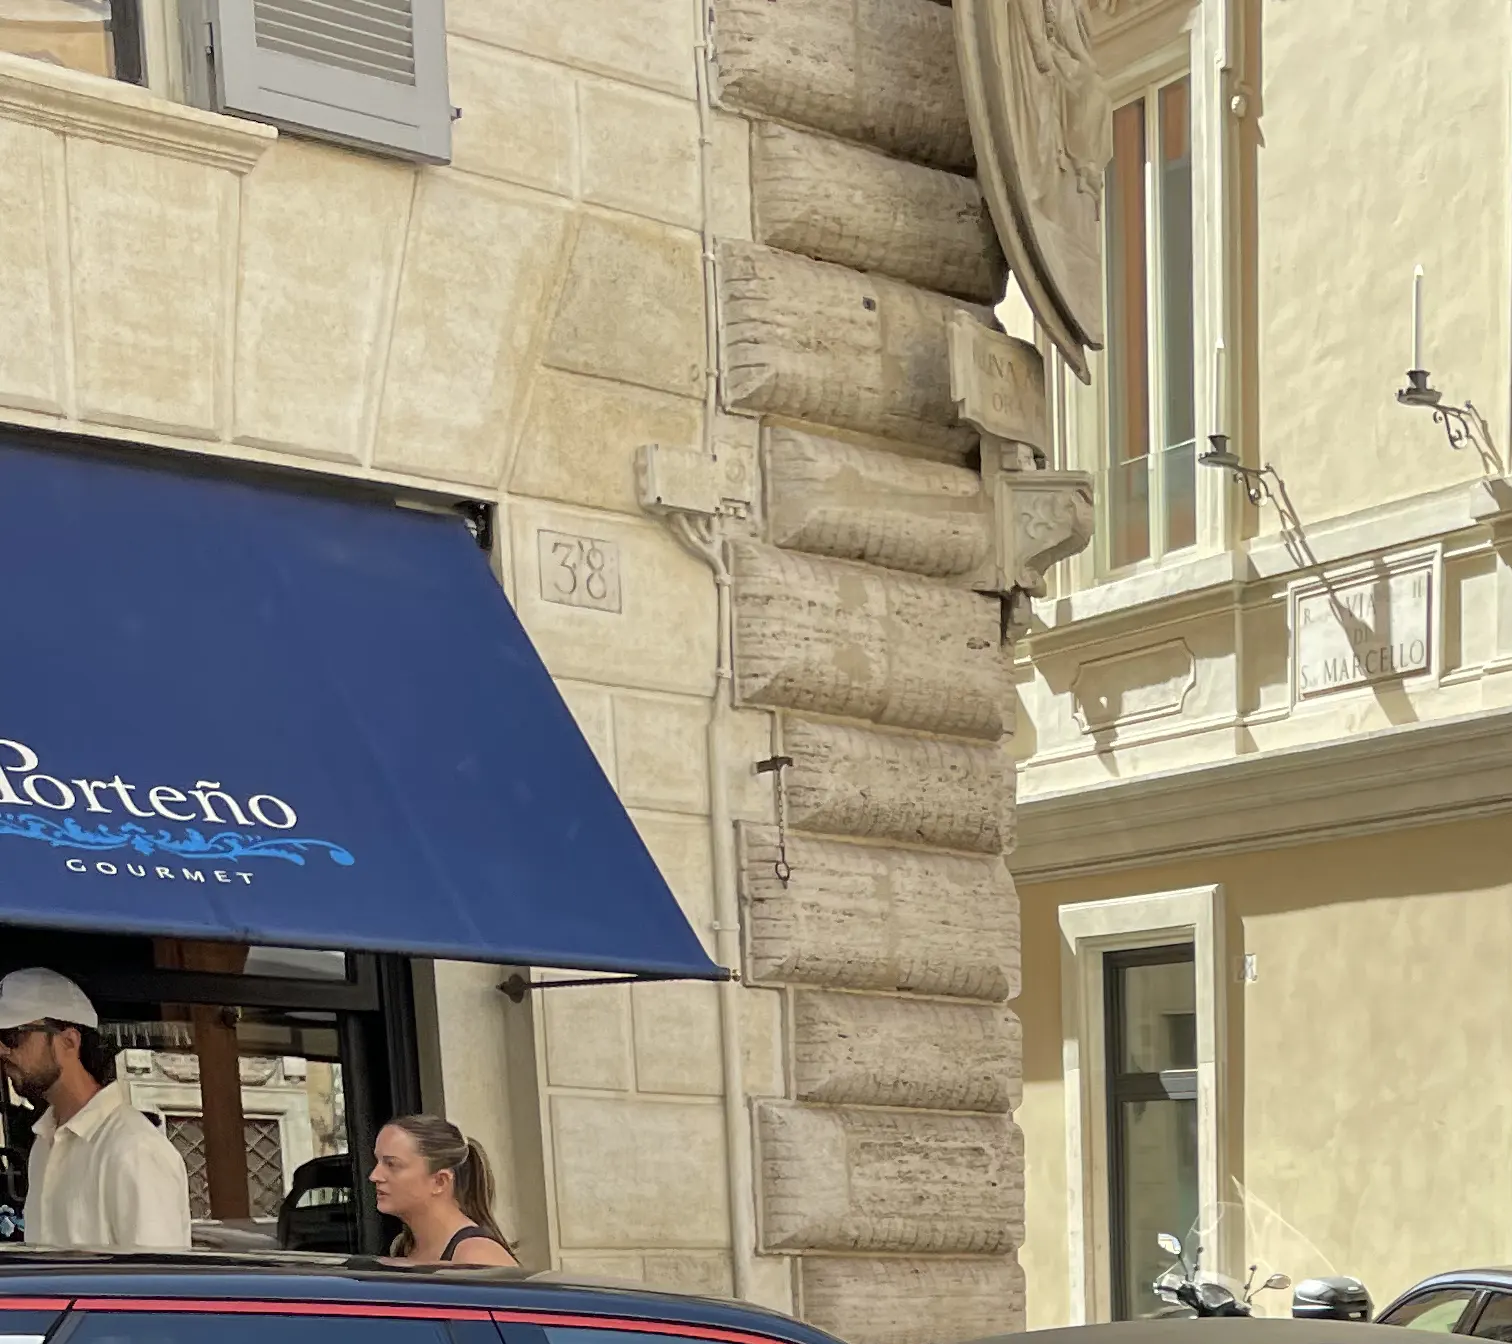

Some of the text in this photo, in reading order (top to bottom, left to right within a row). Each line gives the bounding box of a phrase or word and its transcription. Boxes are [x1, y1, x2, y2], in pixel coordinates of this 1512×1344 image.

[551, 540, 608, 600] 38
[1345, 591, 1378, 619] VIA
[1353, 625, 1369, 646] DI
[1323, 638, 1426, 686] MARCELLO
[65, 858, 254, 886] GOURMET
